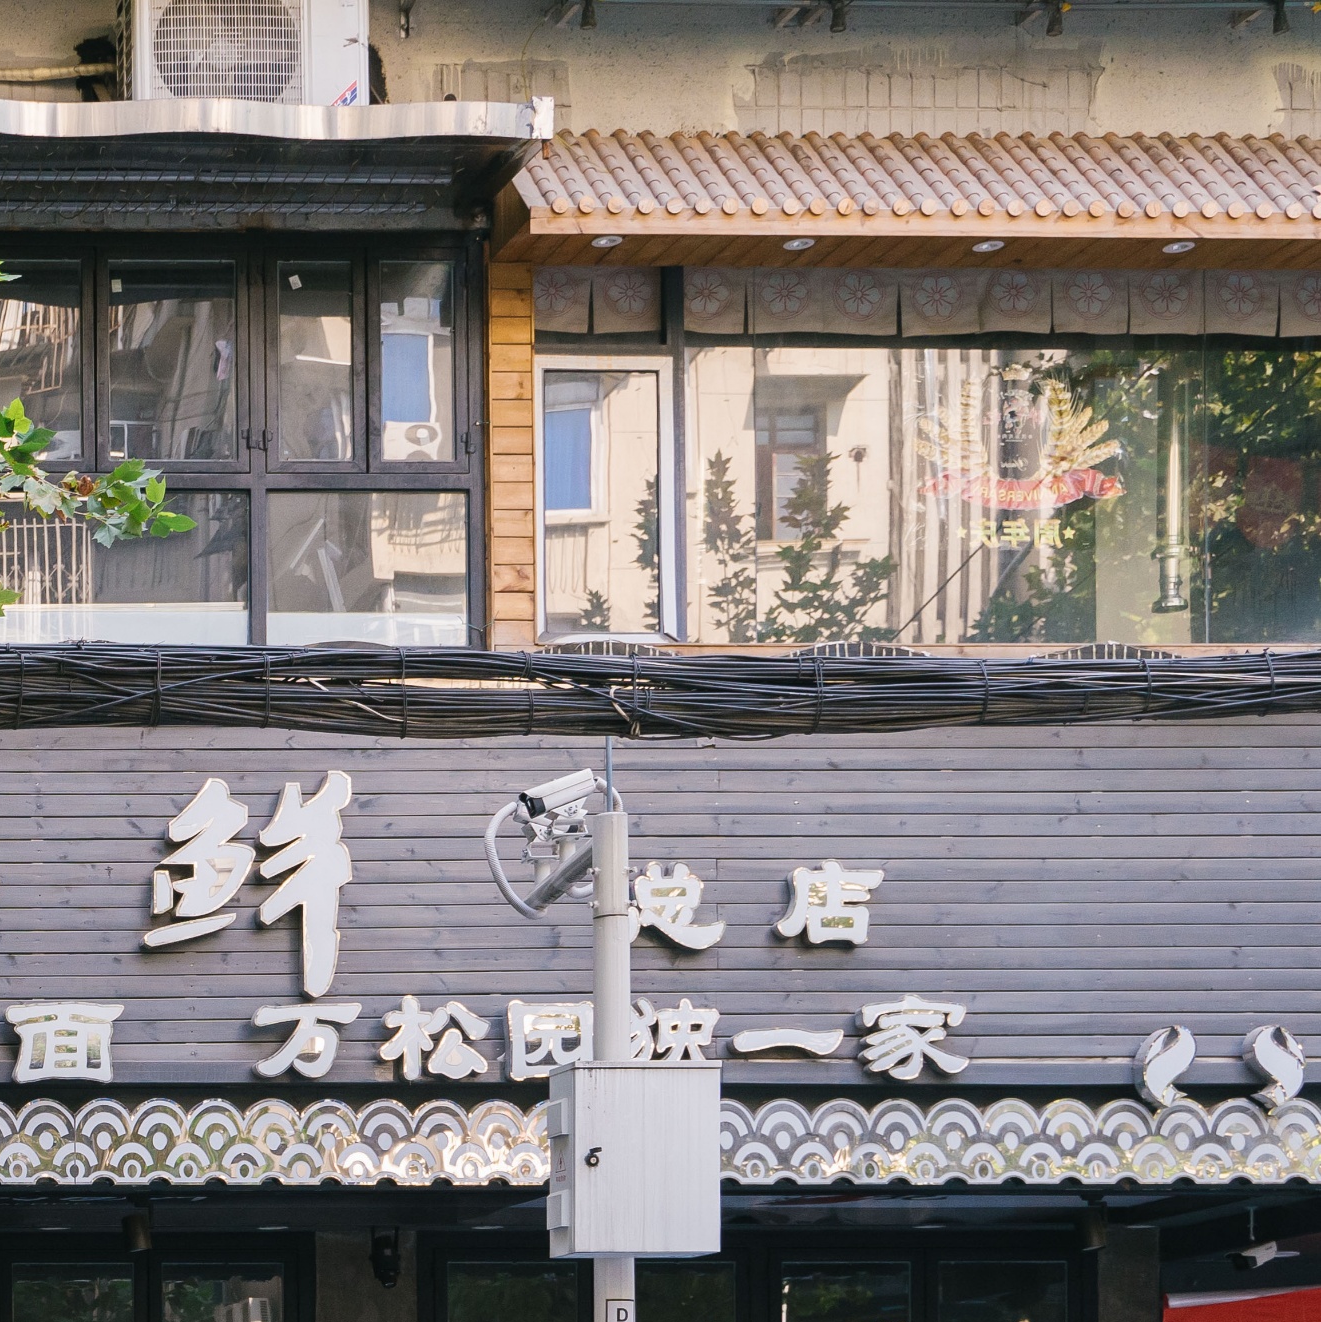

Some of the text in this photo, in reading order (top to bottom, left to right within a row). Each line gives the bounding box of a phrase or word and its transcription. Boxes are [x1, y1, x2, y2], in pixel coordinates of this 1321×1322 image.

[628, 859, 885, 950] 总店
[251, 993, 971, 1082] 万松园独一家
